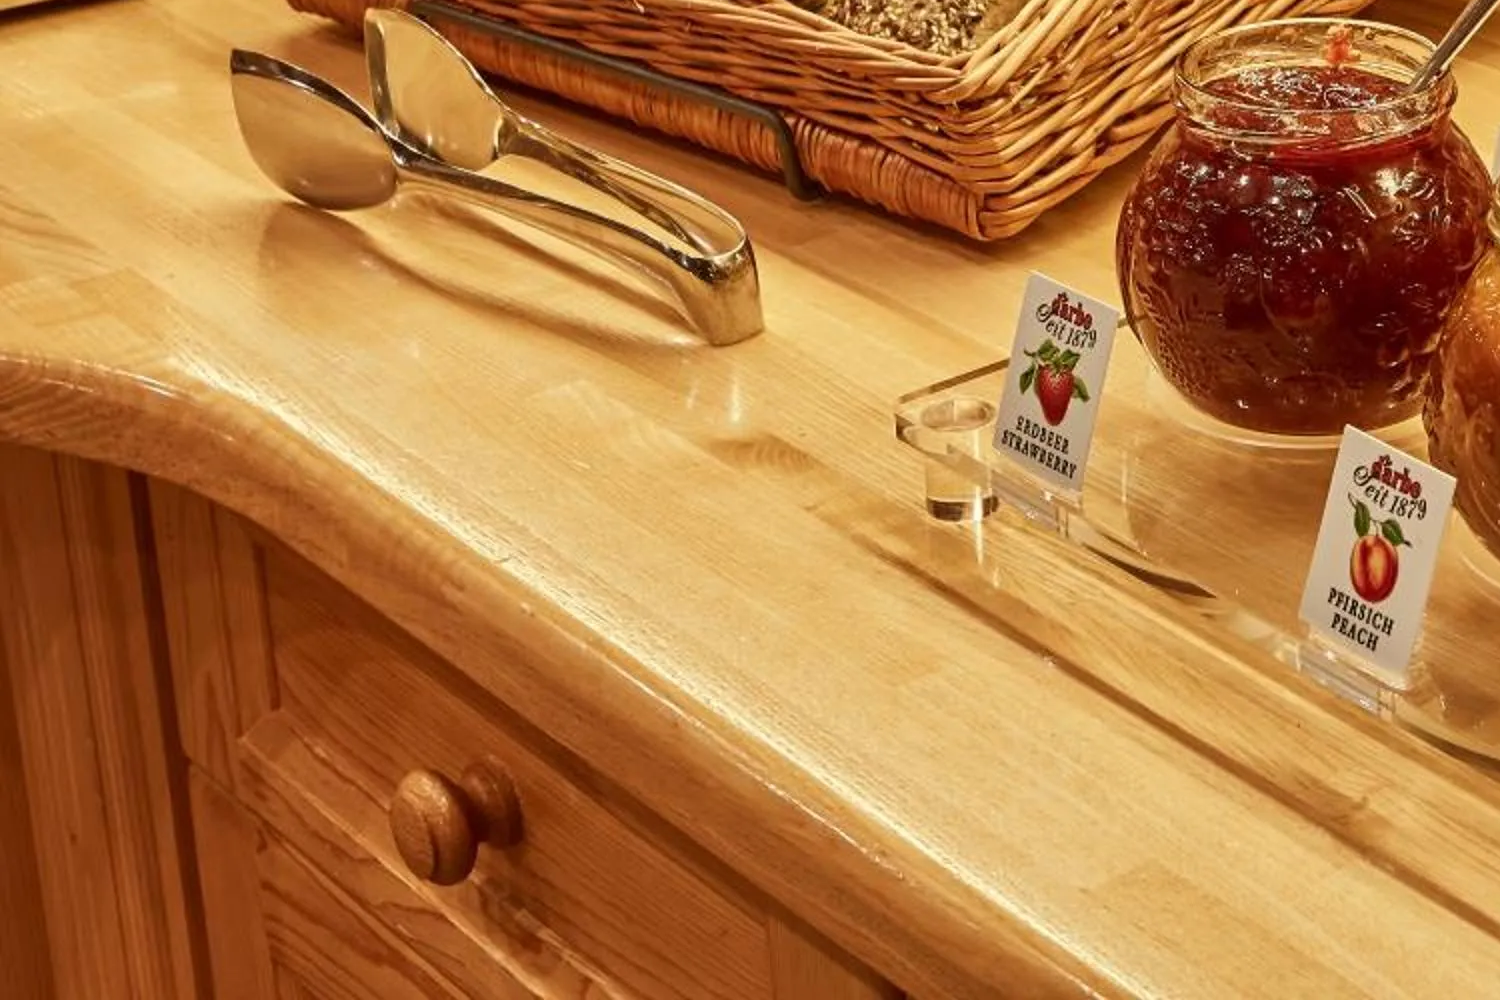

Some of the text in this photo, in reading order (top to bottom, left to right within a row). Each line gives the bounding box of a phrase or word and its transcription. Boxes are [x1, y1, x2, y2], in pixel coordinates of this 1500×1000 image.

[1035, 303, 1098, 350] Seit 1879
[1001, 430, 1078, 479] STRAWBERRY
[1016, 415, 1069, 456] ERDBEER
[1353, 465, 1428, 521] Seit 1879
[1327, 587, 1395, 636] PFIRSICH
[1331, 611, 1380, 652] PEACH
